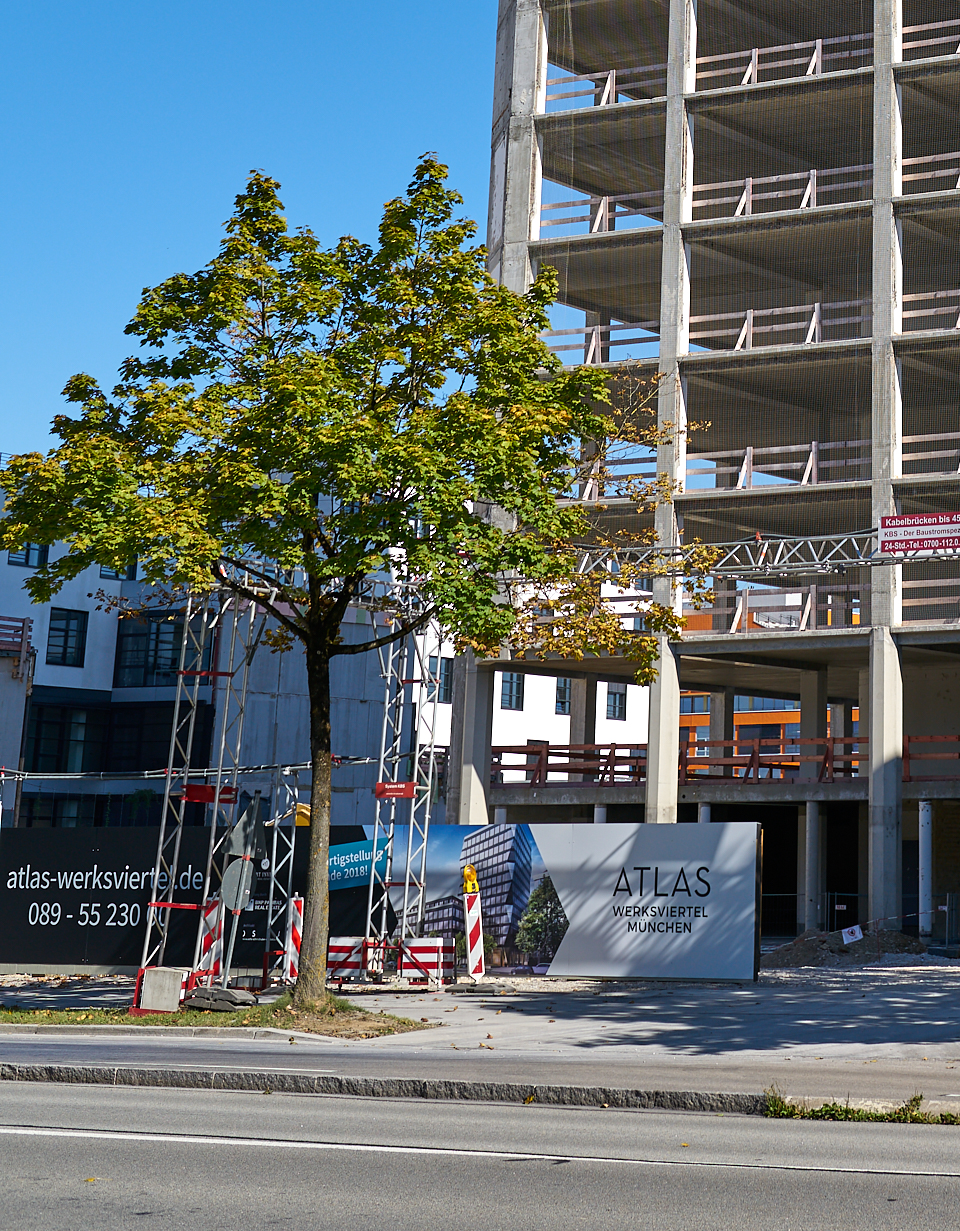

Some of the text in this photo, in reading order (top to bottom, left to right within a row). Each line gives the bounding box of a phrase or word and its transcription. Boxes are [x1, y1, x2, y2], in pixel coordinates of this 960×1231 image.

[885, 516, 937, 526] Kabelbrücken
[938, 514, 950, 523] bis
[951, 514, 960, 522] 45
[343, 865, 368, 879] 2018!
[612, 866, 711, 897] ATLAS
[27, 902, 62, 926] 089
[77, 903, 101, 926] 55
[105, 903, 141, 926] 230
[612, 905, 708, 918] WERKSVIERTEL
[627, 918, 692, 933] MÜNCHEN
